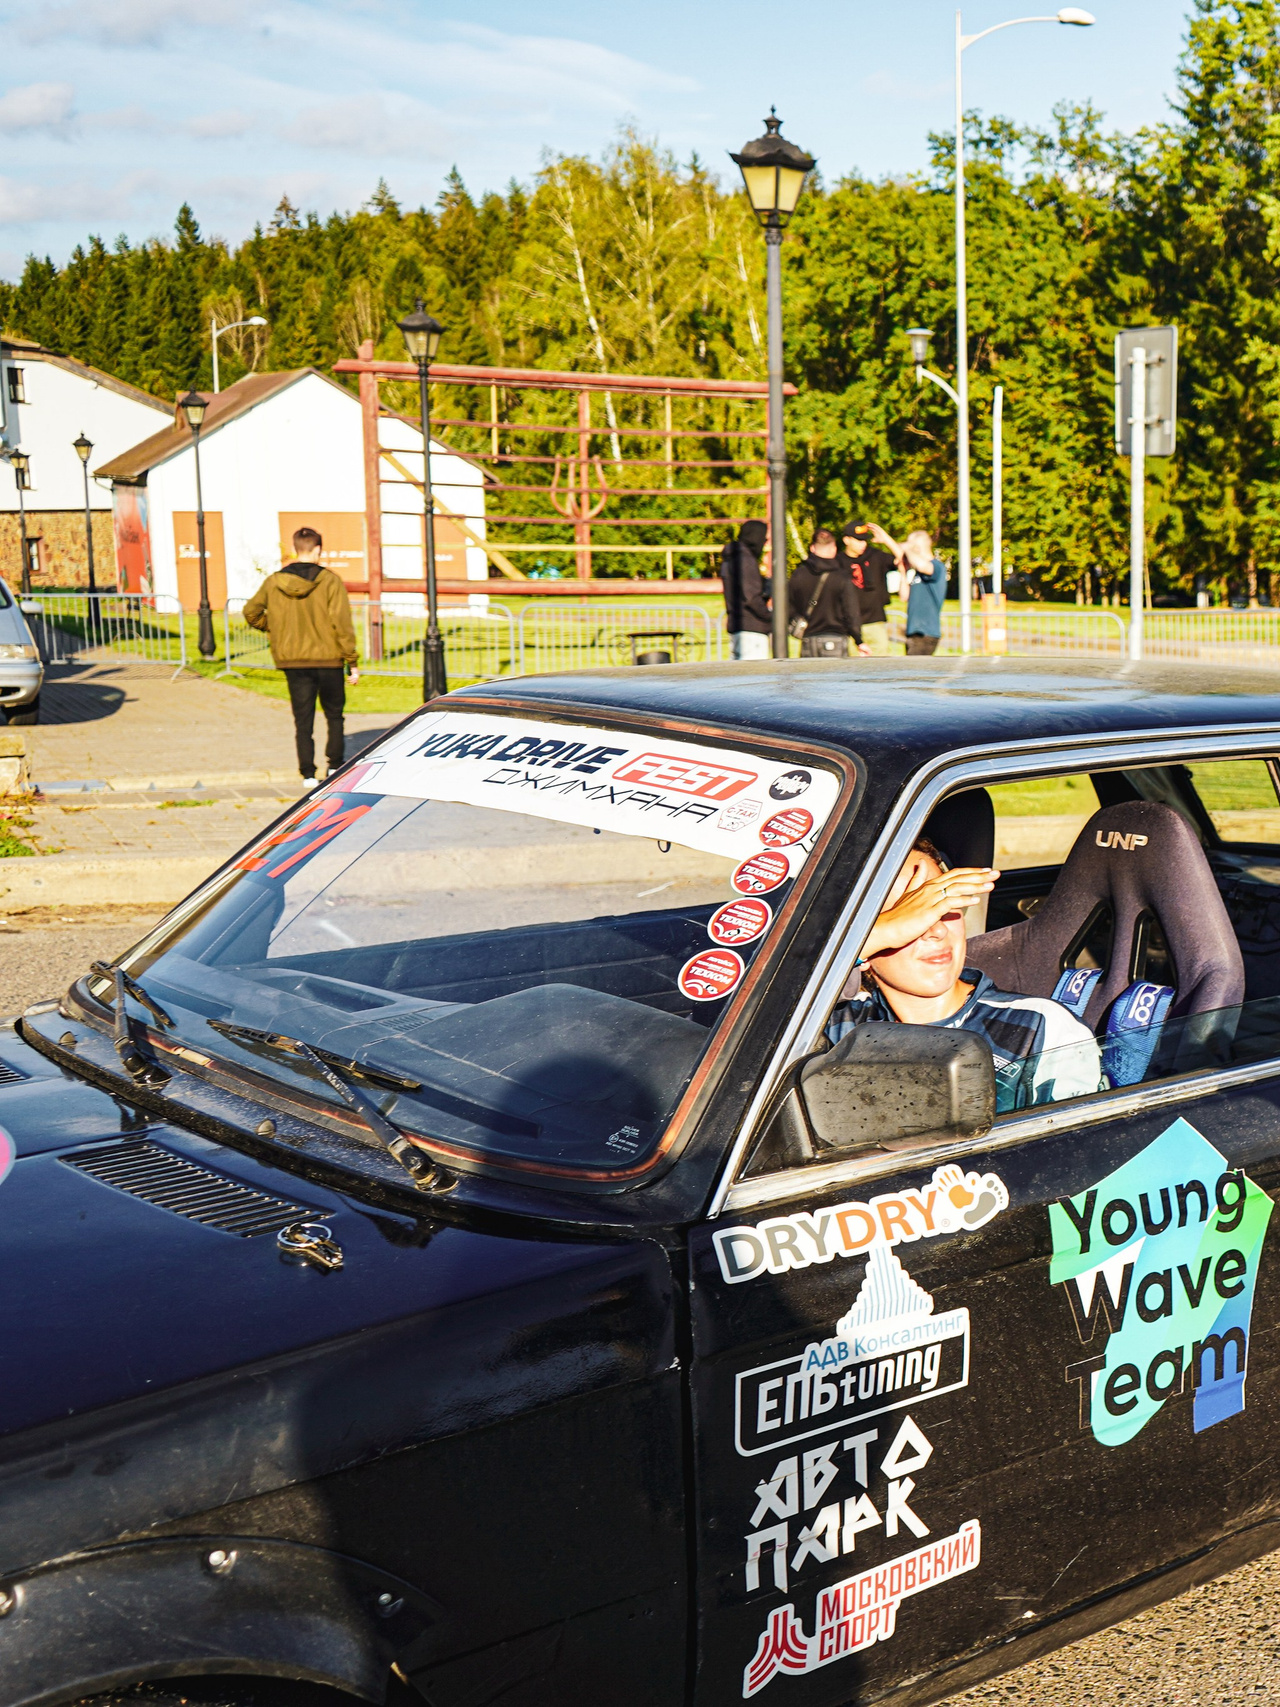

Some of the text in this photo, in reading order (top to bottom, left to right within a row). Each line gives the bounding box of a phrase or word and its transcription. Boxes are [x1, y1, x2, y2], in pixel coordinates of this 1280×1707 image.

[406, 733, 508, 760] YUKA
[486, 736, 629, 774] DRIVE
[615, 754, 757, 798] FEST
[1095, 830, 1149, 851] UNP
[720, 1190, 938, 1278] DRYDRY
[1056, 1168, 1247, 1254] Young
[1064, 1248, 1247, 1344] Wave
[806, 1314, 964, 1371] АДВ Консалтинг
[1065, 1326, 1247, 1430] Team
[749, 1414, 934, 1528] АВТО
[744, 1476, 931, 1594] ПАРК
[820, 1526, 975, 1627] МОСКОВСКИЙ
[818, 1602, 894, 1662] СПОРТ
